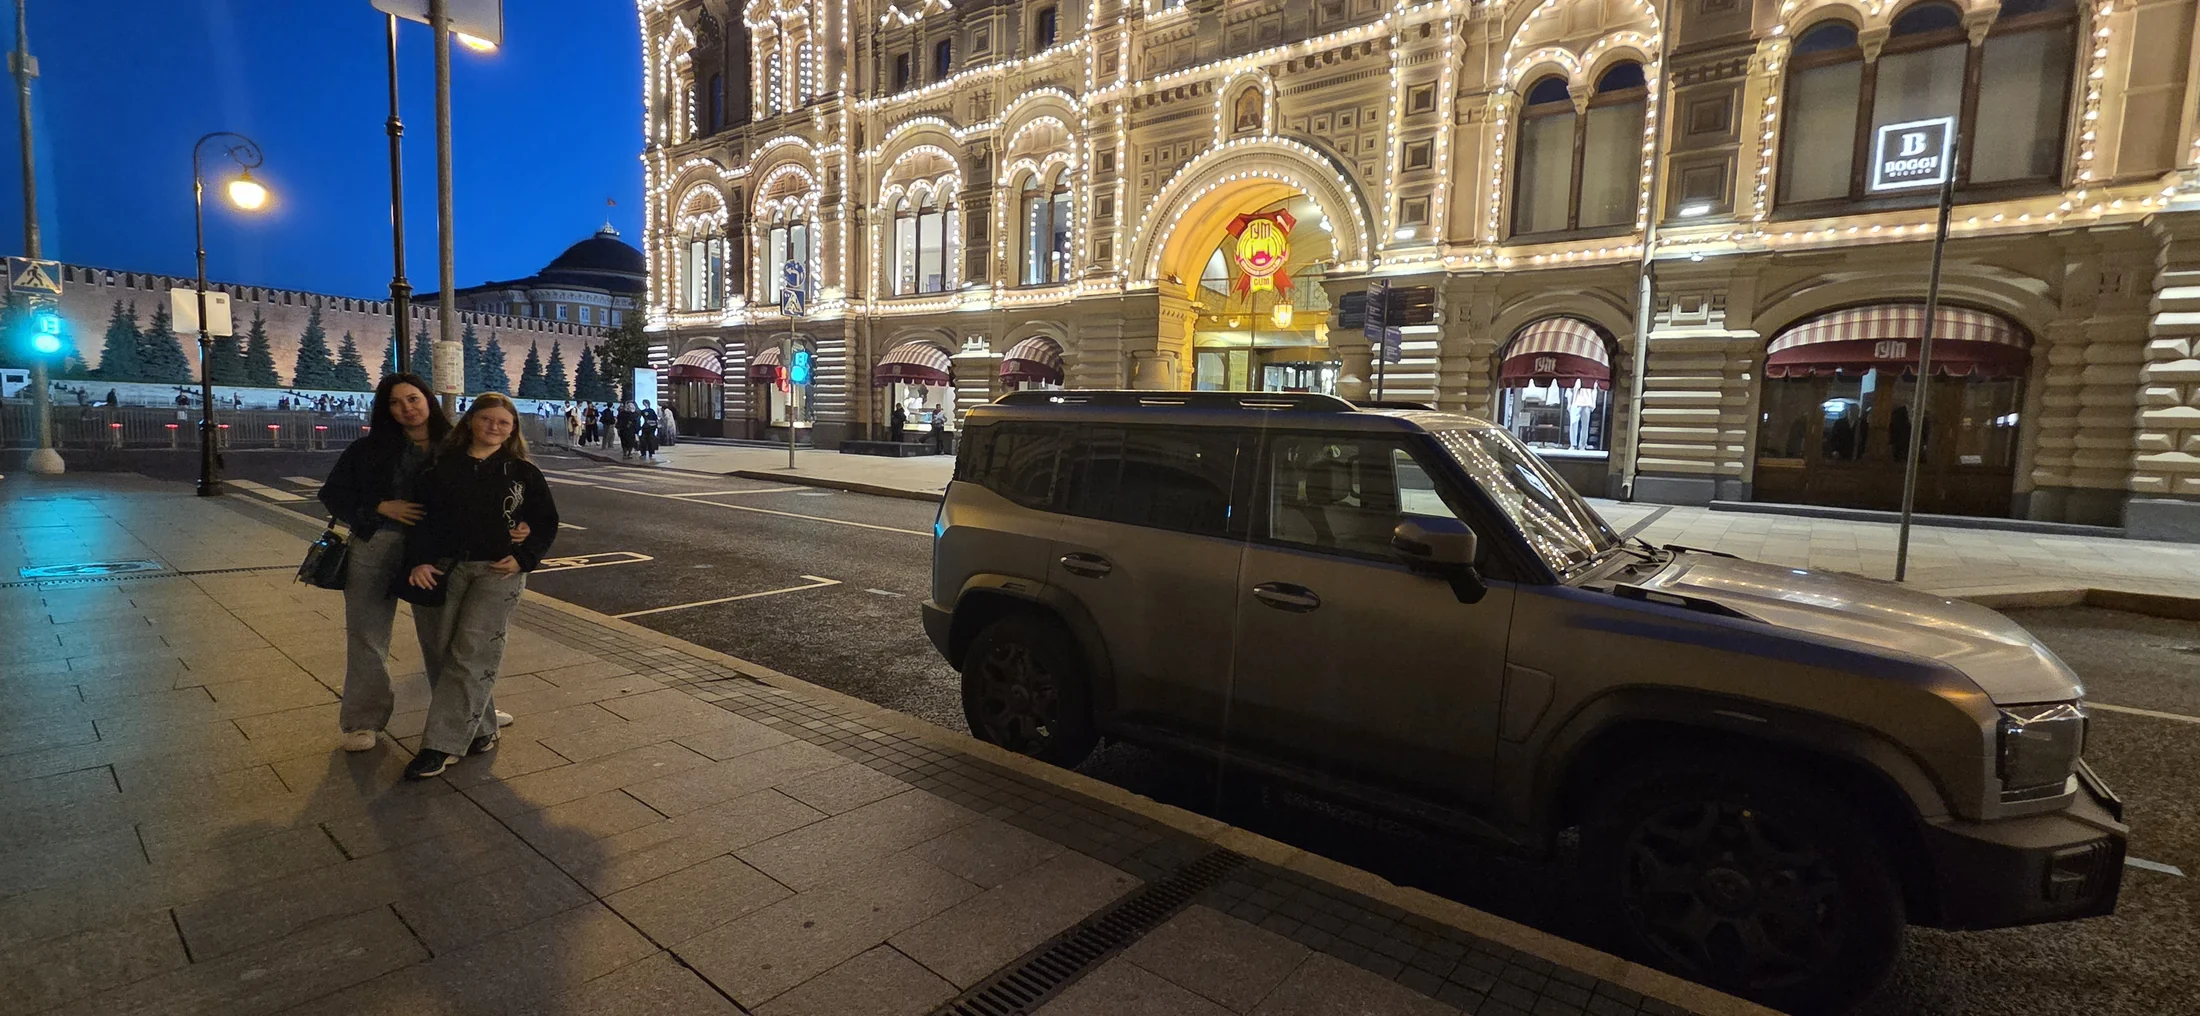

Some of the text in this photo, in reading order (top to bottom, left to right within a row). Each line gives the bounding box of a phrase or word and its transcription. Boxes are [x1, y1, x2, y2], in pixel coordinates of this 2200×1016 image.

[1900, 131, 1927, 157] B
[1884, 155, 1939, 173] BOGGI
[1875, 341, 1906, 359] ГУМ
